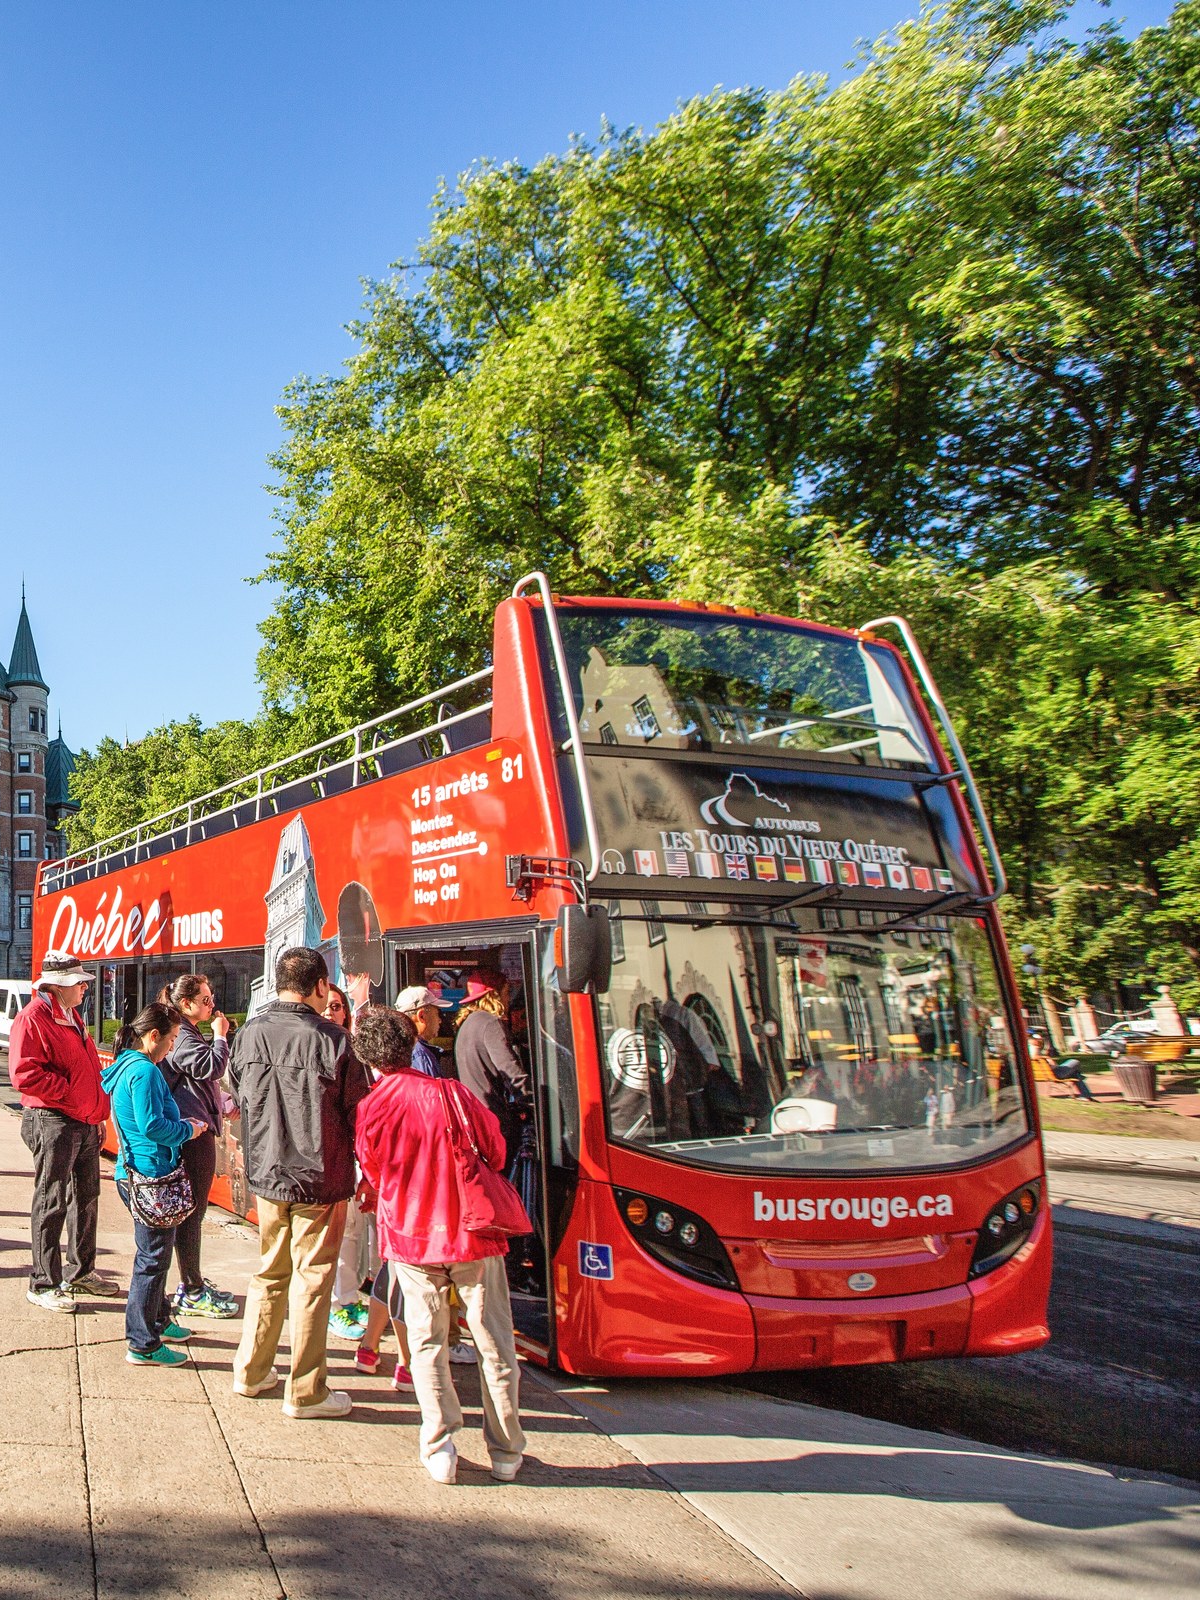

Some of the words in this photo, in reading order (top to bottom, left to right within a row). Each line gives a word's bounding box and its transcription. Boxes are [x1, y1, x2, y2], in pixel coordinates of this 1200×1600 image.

[501, 753, 523, 783] 81
[411, 785, 431, 808] 15
[435, 771, 489, 802] arrêts
[411, 814, 454, 835] Montez
[754, 817, 821, 833] AUTOBUS
[411, 830, 477, 856] Descendez
[659, 831, 695, 852] LES
[695, 829, 759, 855] TOURS
[759, 836, 787, 857] DU
[786, 834, 845, 861] VIEUX
[843, 838, 911, 867] QUÉBEC
[413, 867, 437, 884] Hop
[440, 863, 457, 879] On
[414, 889, 438, 906] Hop
[440, 883, 460, 900] Off
[48, 885, 168, 956] Québec
[172, 909, 223, 947] TOURS
[753, 1191, 954, 1228] busrouge.ca
